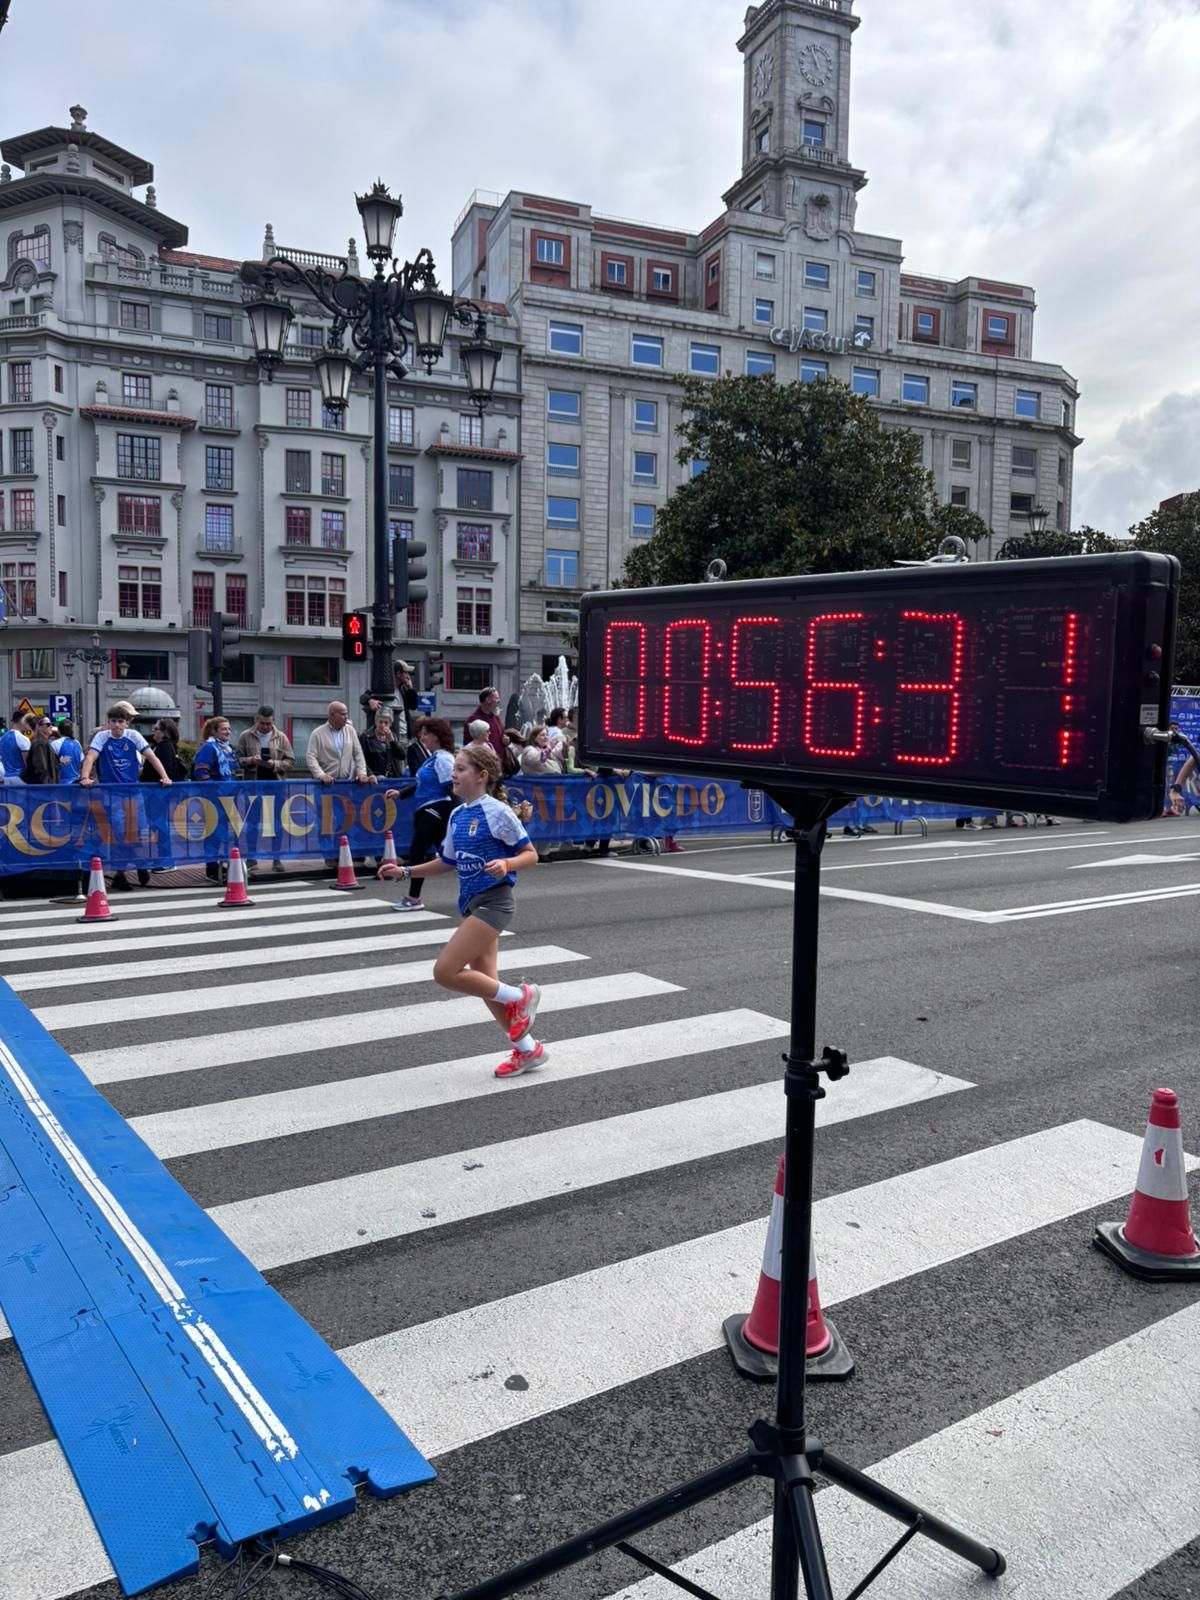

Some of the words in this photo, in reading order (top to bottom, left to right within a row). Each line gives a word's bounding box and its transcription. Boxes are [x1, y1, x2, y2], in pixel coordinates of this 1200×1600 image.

[55, 695, 68, 712] P
[172, 793, 398, 841] OVIEDO
[585, 782, 725, 820] OVIEDO
